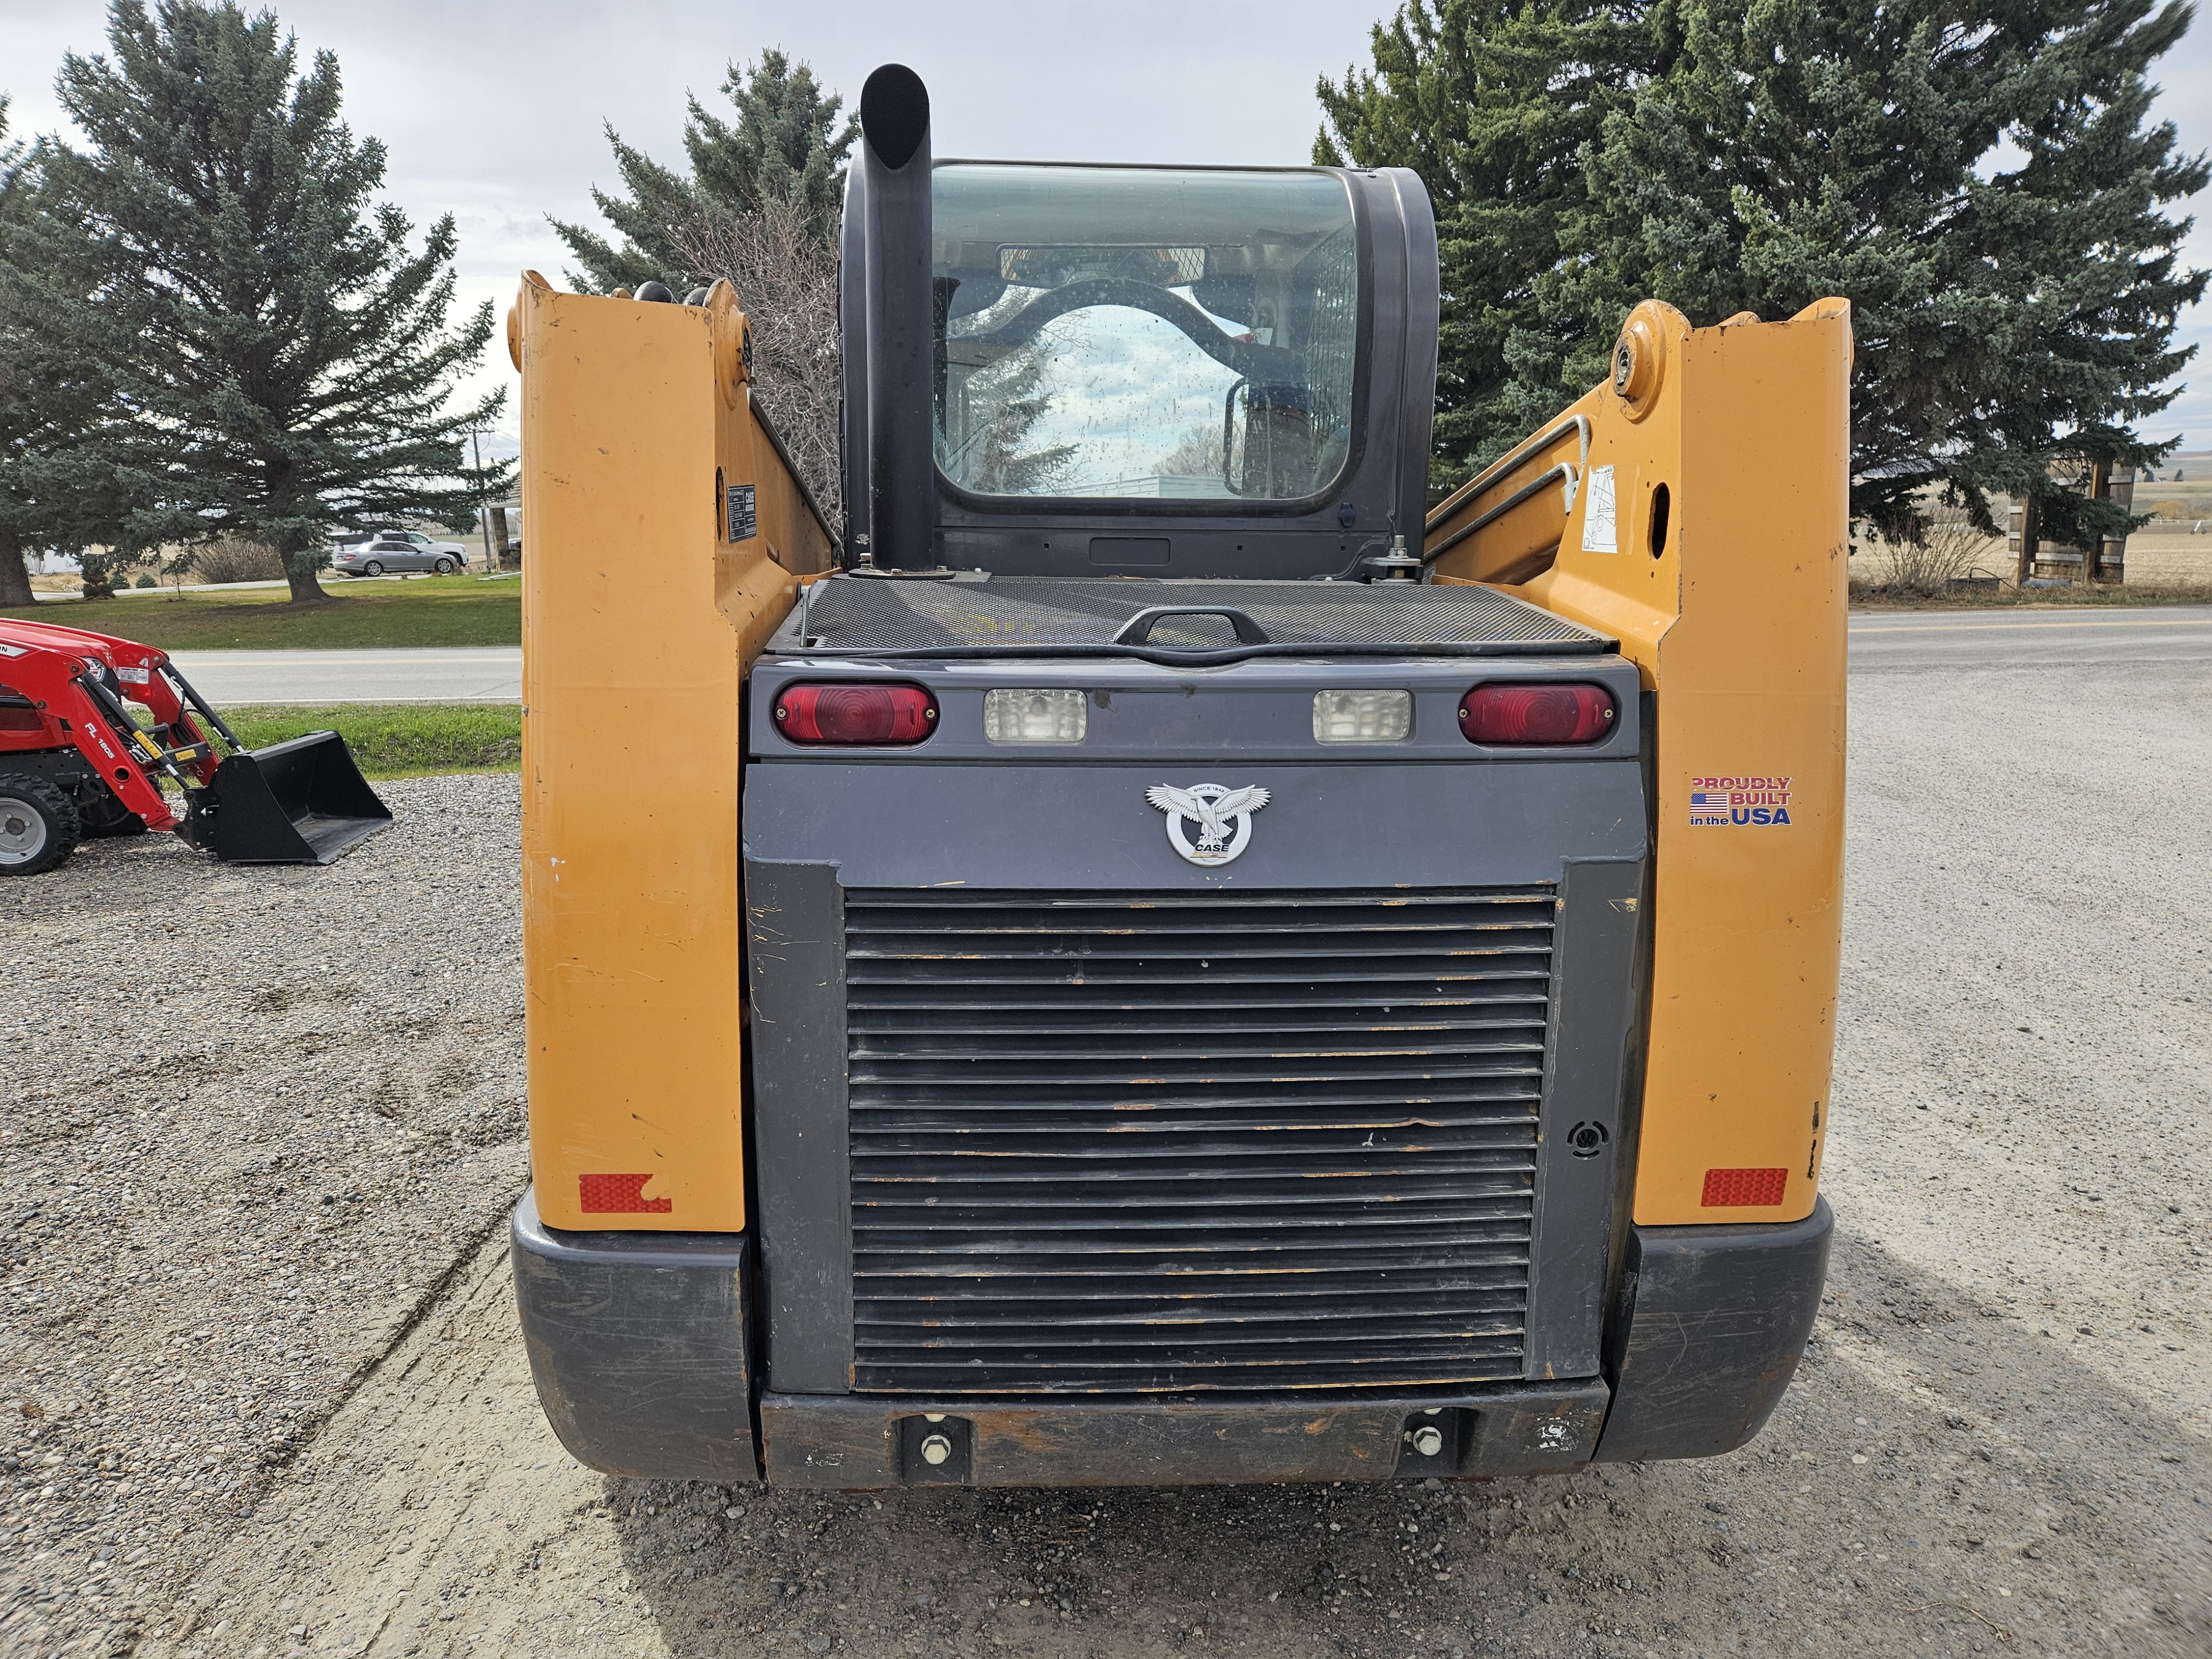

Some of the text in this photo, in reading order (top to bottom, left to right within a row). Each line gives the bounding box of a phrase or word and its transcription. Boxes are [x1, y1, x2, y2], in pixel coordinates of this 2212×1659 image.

[745, 491, 754, 503] CASE
[84, 722, 115, 759] FL 1805
[1692, 777, 1792, 790] PROUDLY
[1730, 792, 1792, 806] BUILT
[1690, 807, 1792, 826] in the USA
